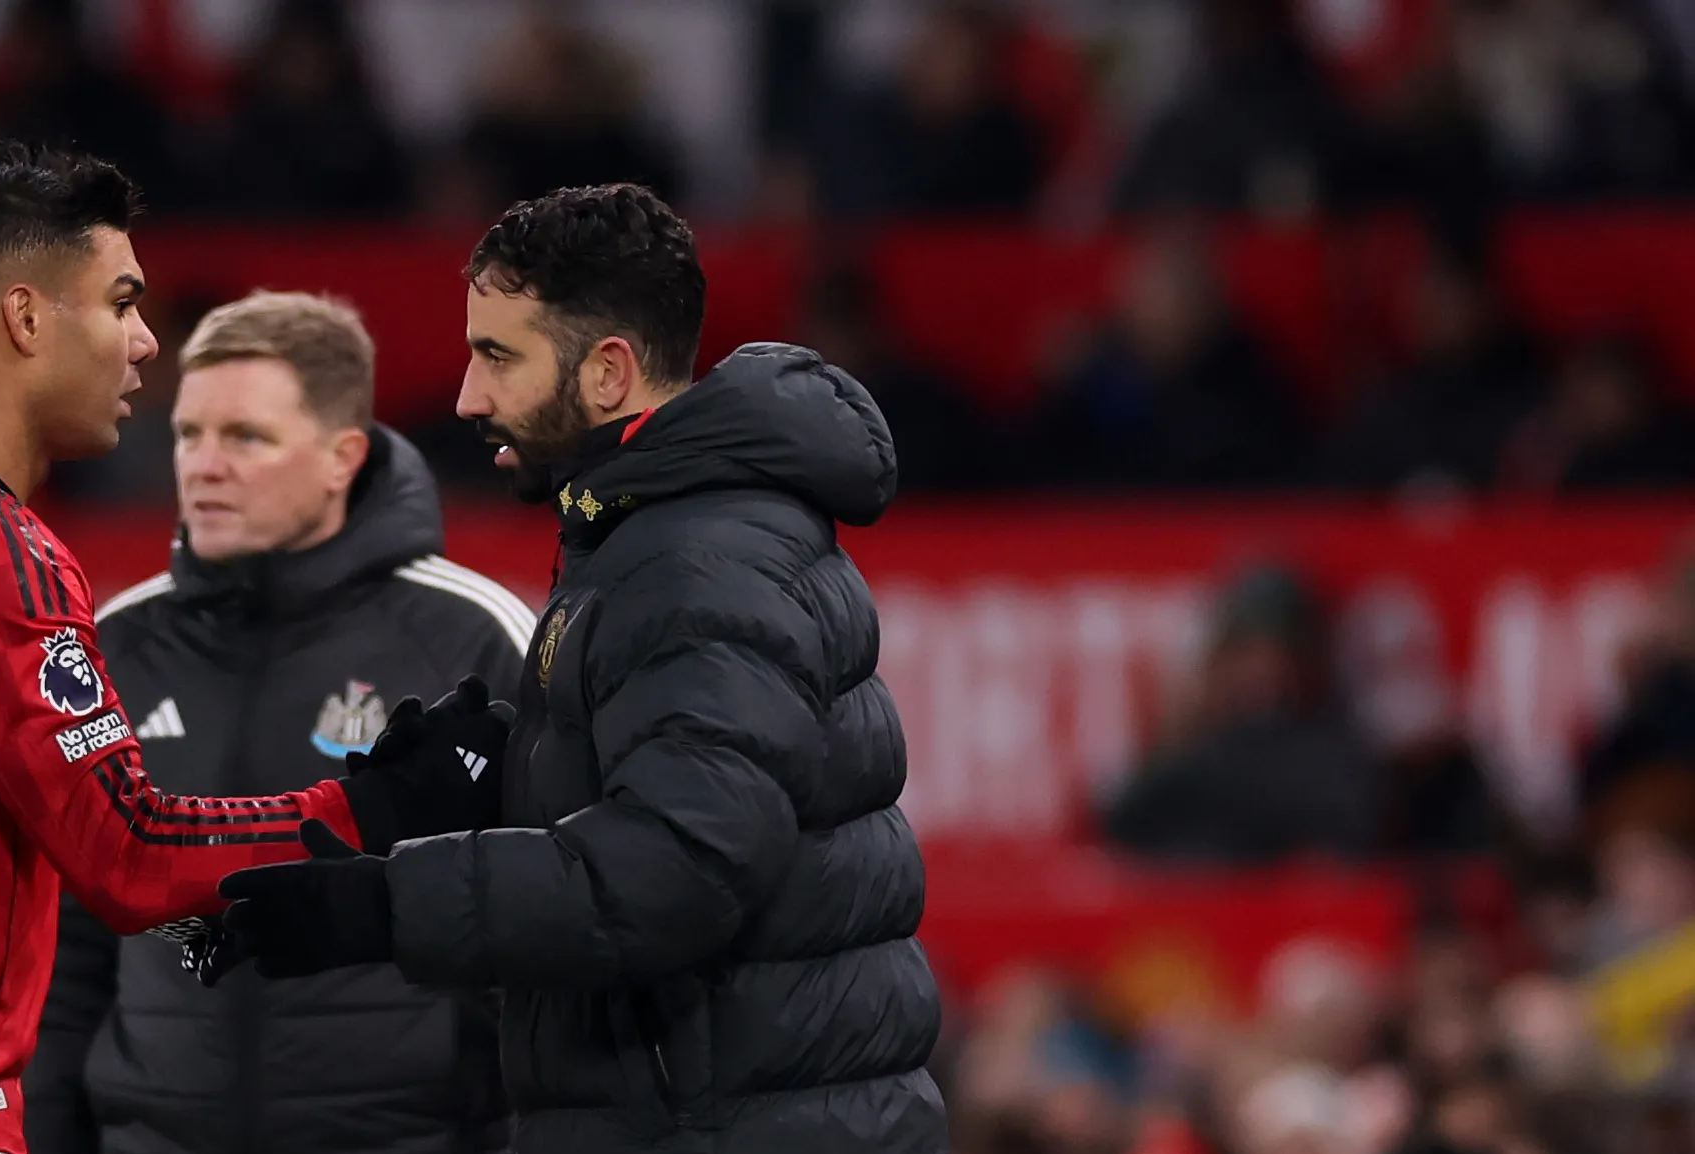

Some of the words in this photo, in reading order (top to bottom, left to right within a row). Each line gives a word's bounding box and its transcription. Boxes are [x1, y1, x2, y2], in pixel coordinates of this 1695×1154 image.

[55, 730, 83, 751] No
[81, 713, 121, 738] room
[64, 742, 88, 763] for
[88, 724, 131, 751] racism
